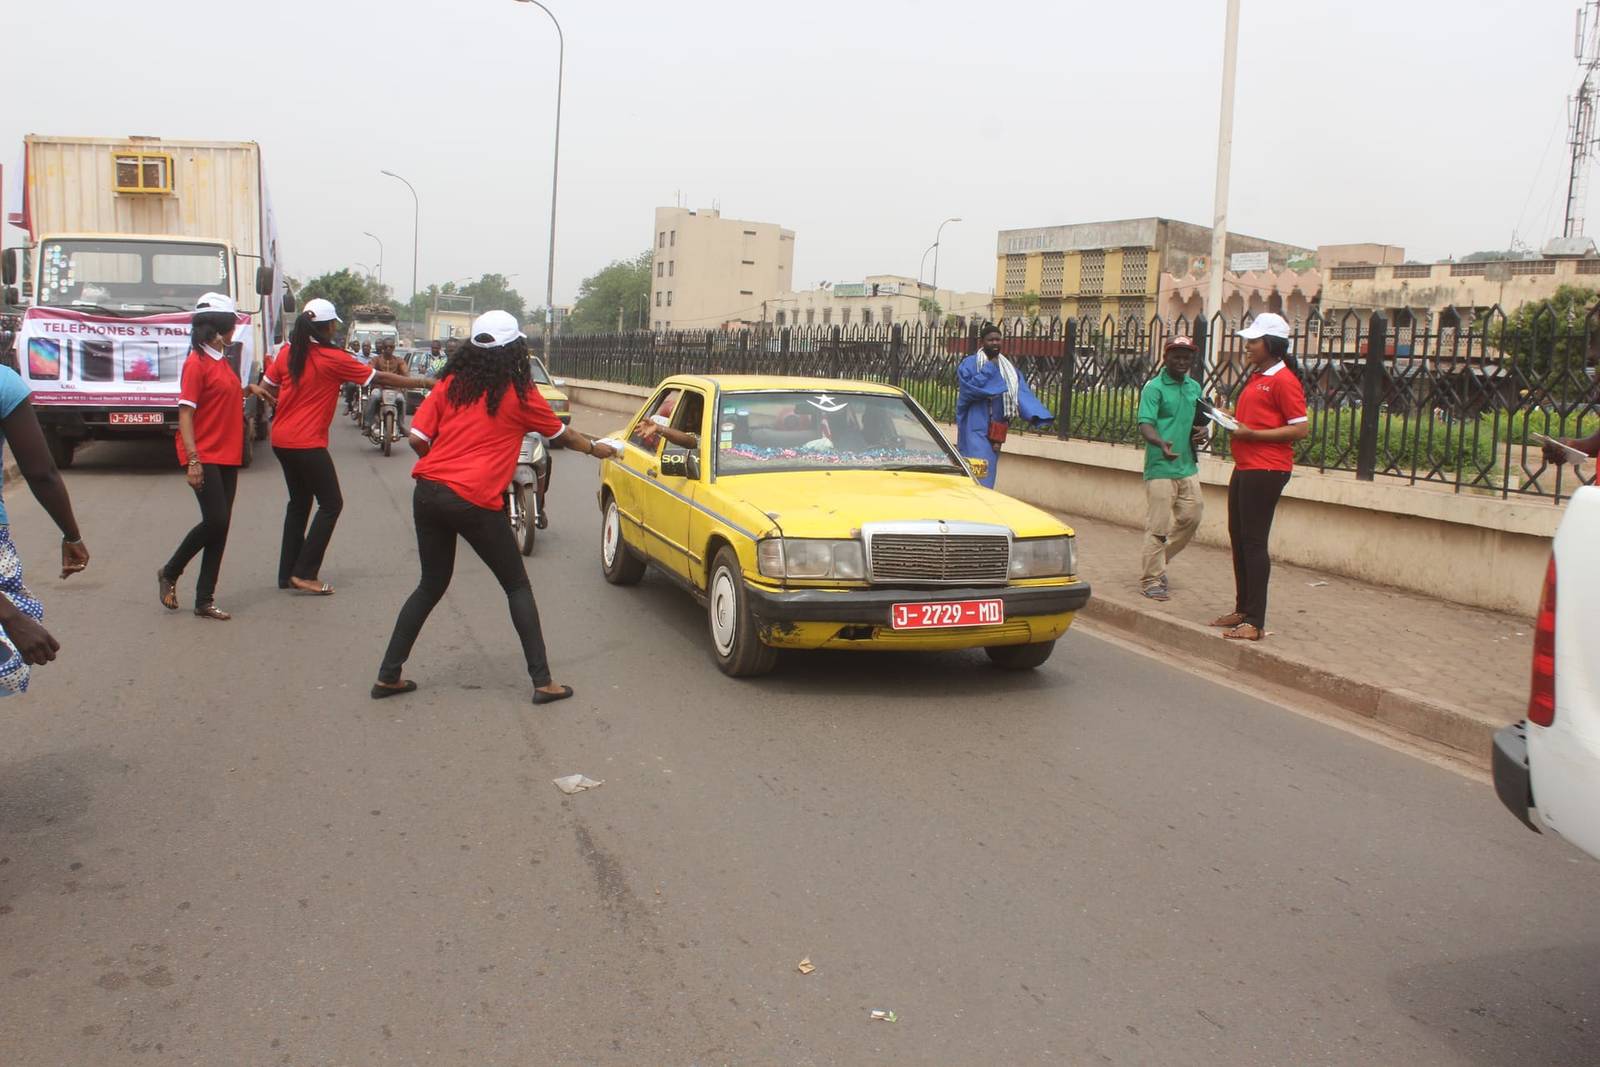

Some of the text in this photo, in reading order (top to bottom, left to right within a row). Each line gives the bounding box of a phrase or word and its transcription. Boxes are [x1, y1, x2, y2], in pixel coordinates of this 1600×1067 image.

[43, 322, 191, 337] TELEPHONES & TABL
